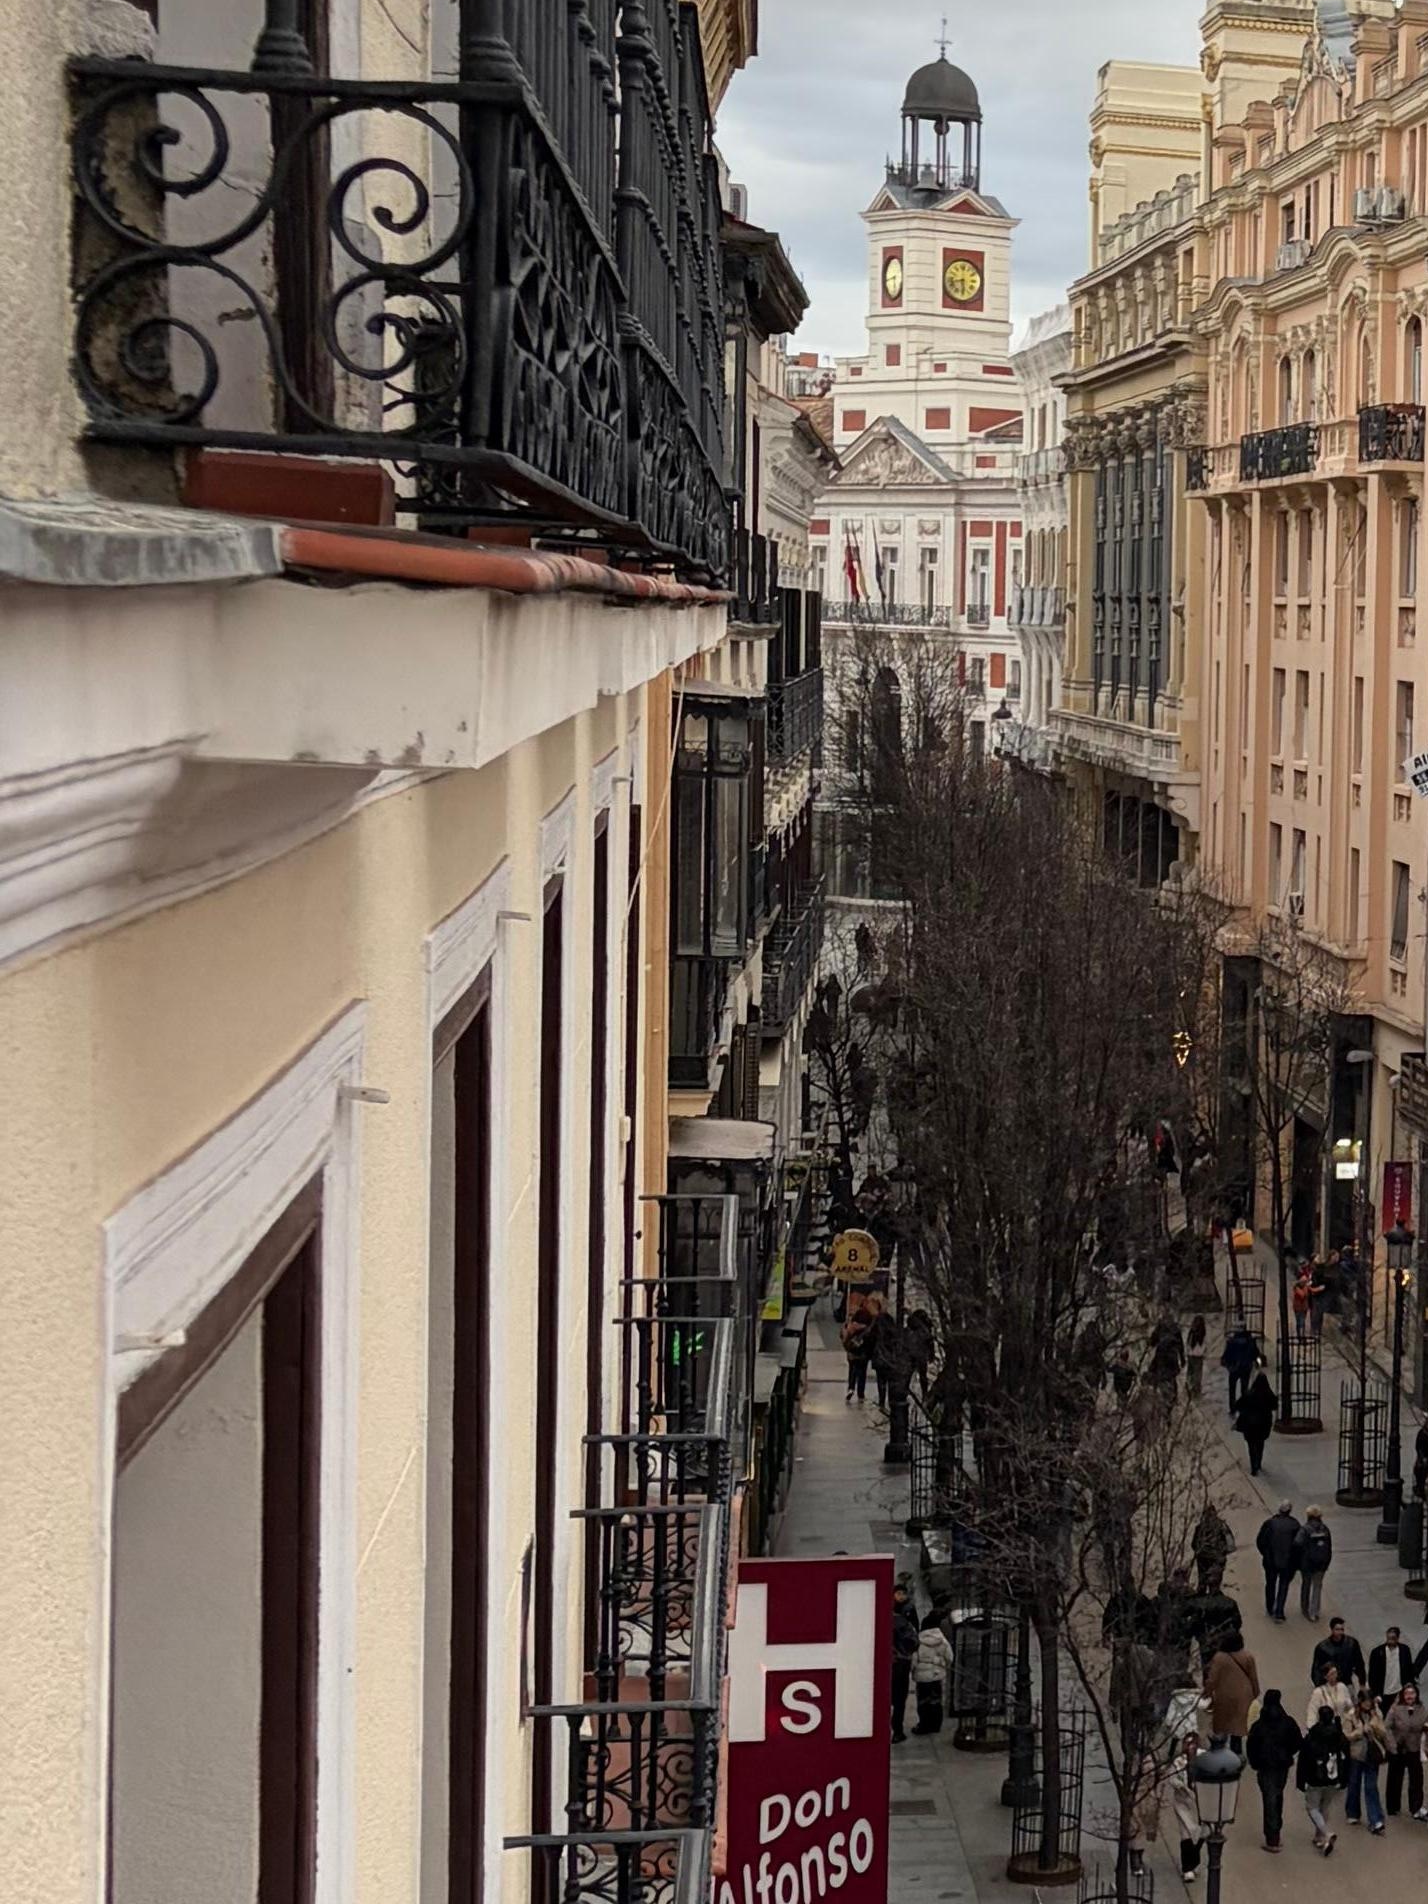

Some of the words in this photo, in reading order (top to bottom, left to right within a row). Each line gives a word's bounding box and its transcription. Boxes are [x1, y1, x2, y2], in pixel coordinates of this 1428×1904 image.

[847, 1248, 858, 1262] 8
[728, 1580, 875, 1742] H
[759, 1776, 851, 1845] Don
